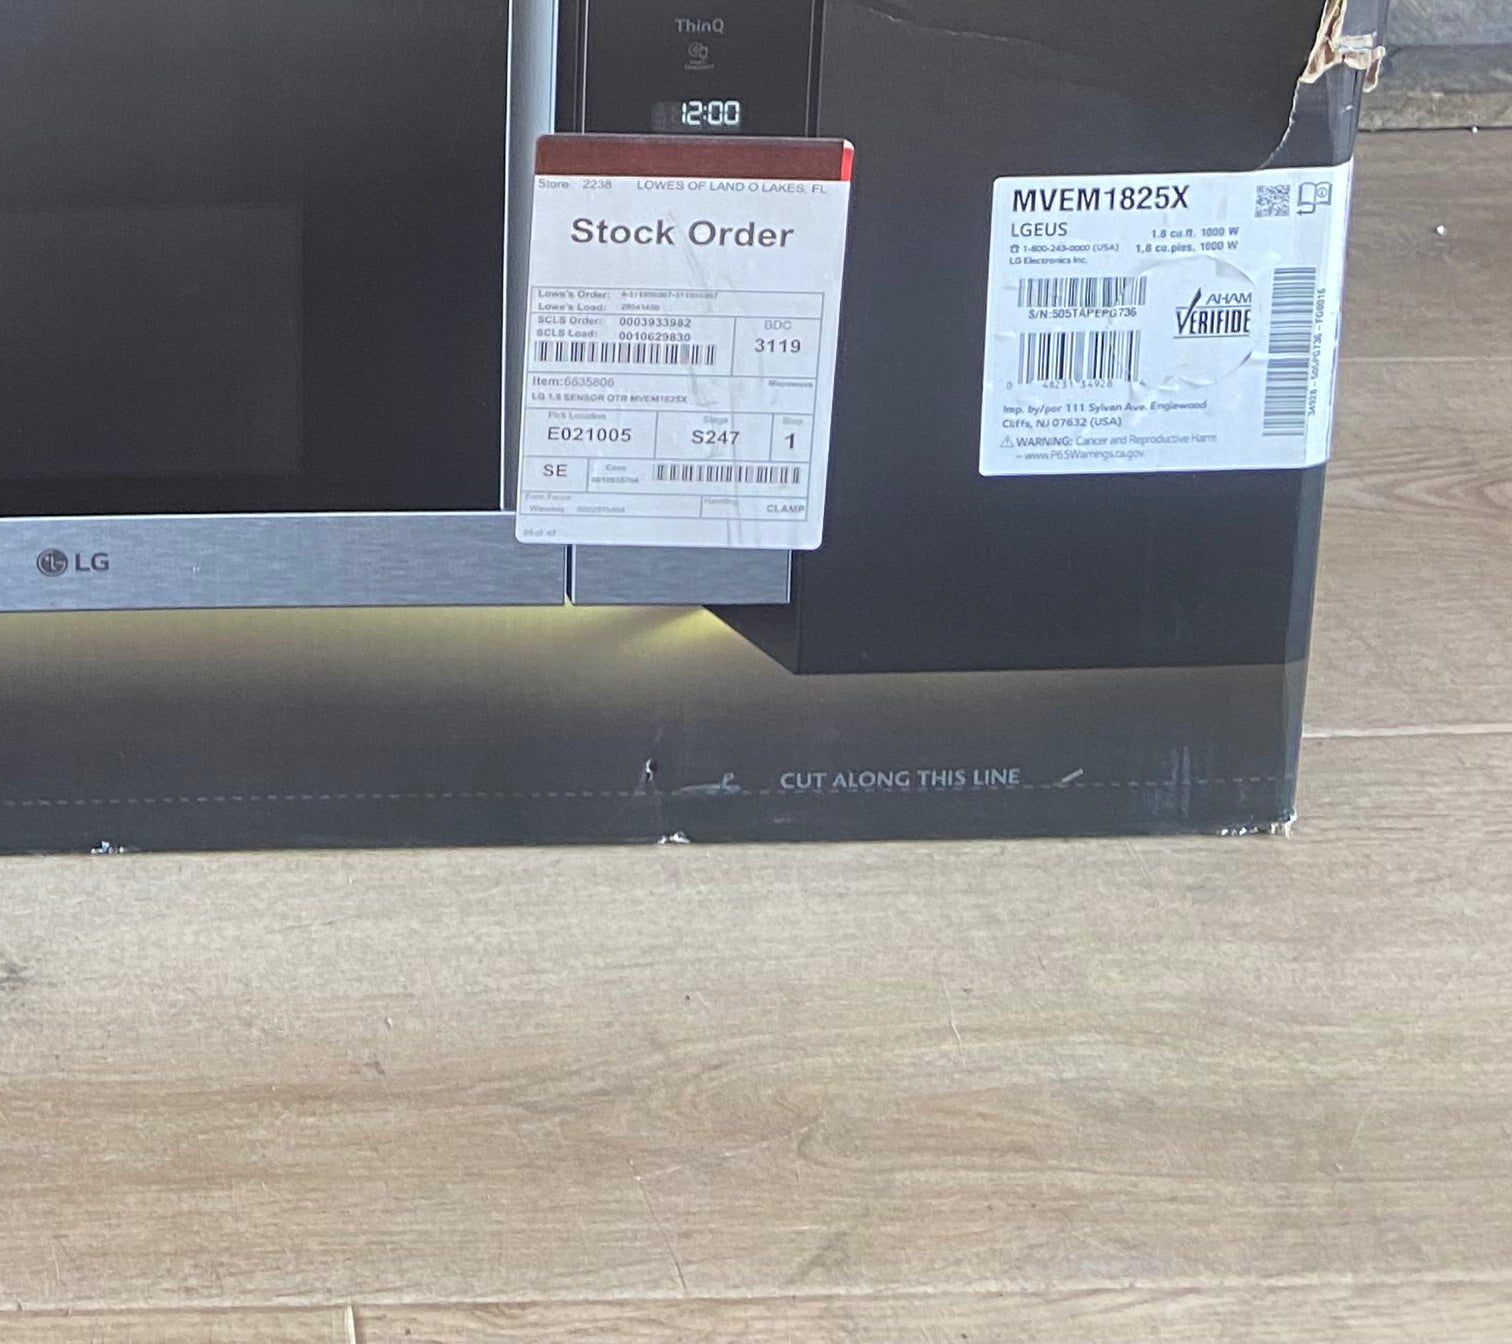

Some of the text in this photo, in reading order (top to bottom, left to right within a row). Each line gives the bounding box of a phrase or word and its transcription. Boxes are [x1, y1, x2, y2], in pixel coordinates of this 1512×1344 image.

[674, 17, 724, 34] ThinQ
[681, 100, 740, 126] 12:00
[538, 179, 827, 194] Store 2238 LOWES OF LAND O FL
[1012, 184, 1189, 213] MVEM1825X
[571, 217, 795, 248] Stock Order
[1011, 221, 1069, 238] LGEUS
[1201, 226, 1240, 237] 1000 W
[1092, 243, 1120, 253] (USA)
[1200, 240, 1239, 251] 1000 W
[1206, 292, 1252, 305] AHAM
[764, 320, 792, 330] BDC
[754, 338, 802, 354] 3119
[1066, 403, 1085, 413] 111
[1088, 402, 1122, 414] Sylvan
[1124, 402, 1147, 412] Ave.
[1150, 400, 1208, 412] Englewood
[1036, 419, 1050, 428] NJ
[1052, 418, 1087, 427] 07632
[1090, 417, 1122, 428] (USA)
[547, 426, 632, 442] E021005
[691, 430, 740, 445] S247
[785, 432, 795, 449] 1
[1016, 433, 1217, 447] WARNING: Cancer and Reproductive Harm
[543, 463, 568, 478] SE
[766, 503, 805, 513] CLAMP
[74, 552, 110, 572] LG
[779, 767, 1021, 790] CUT ALONG THIS LINE
